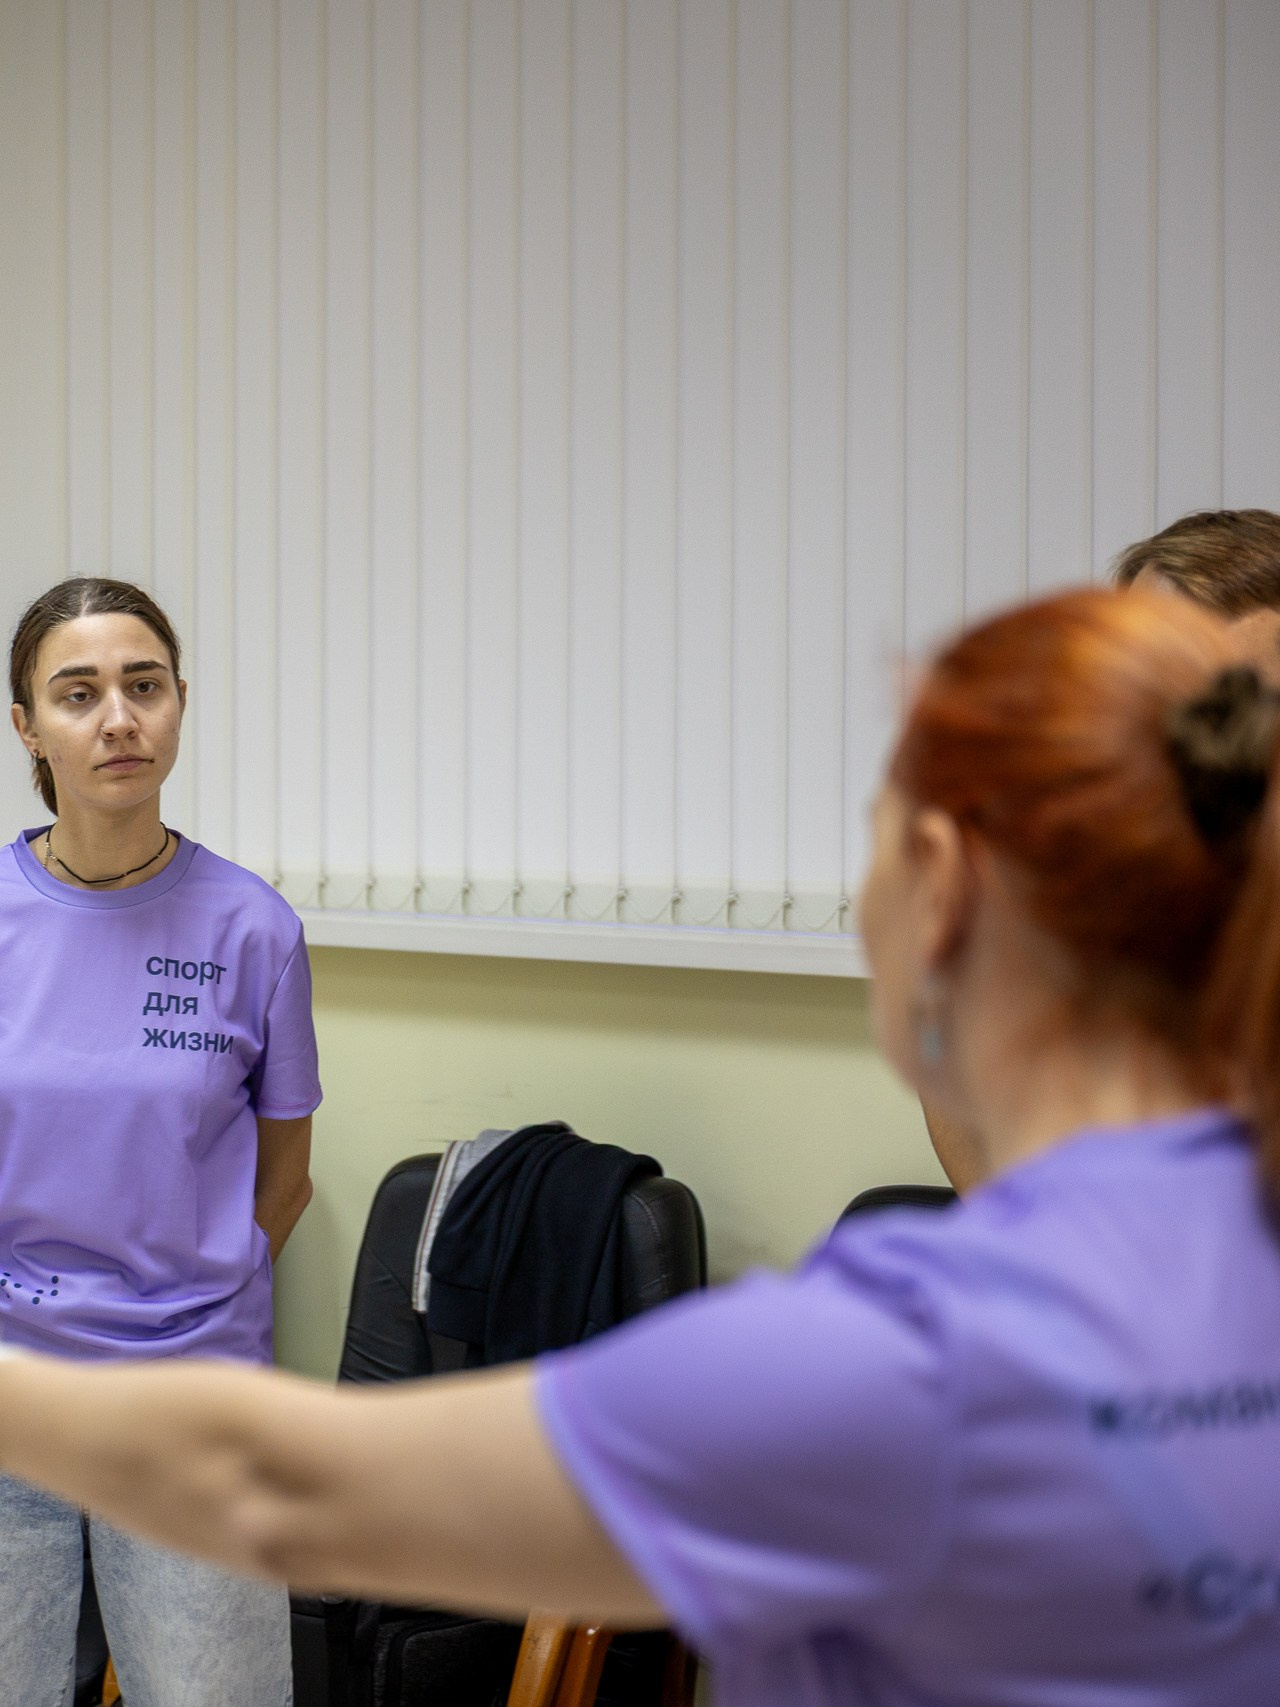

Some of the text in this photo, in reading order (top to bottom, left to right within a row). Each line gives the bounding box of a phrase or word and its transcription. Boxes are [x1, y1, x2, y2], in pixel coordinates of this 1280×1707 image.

[146, 956, 227, 986] спорт
[142, 991, 199, 1017] для
[142, 1027, 234, 1055] жизни
